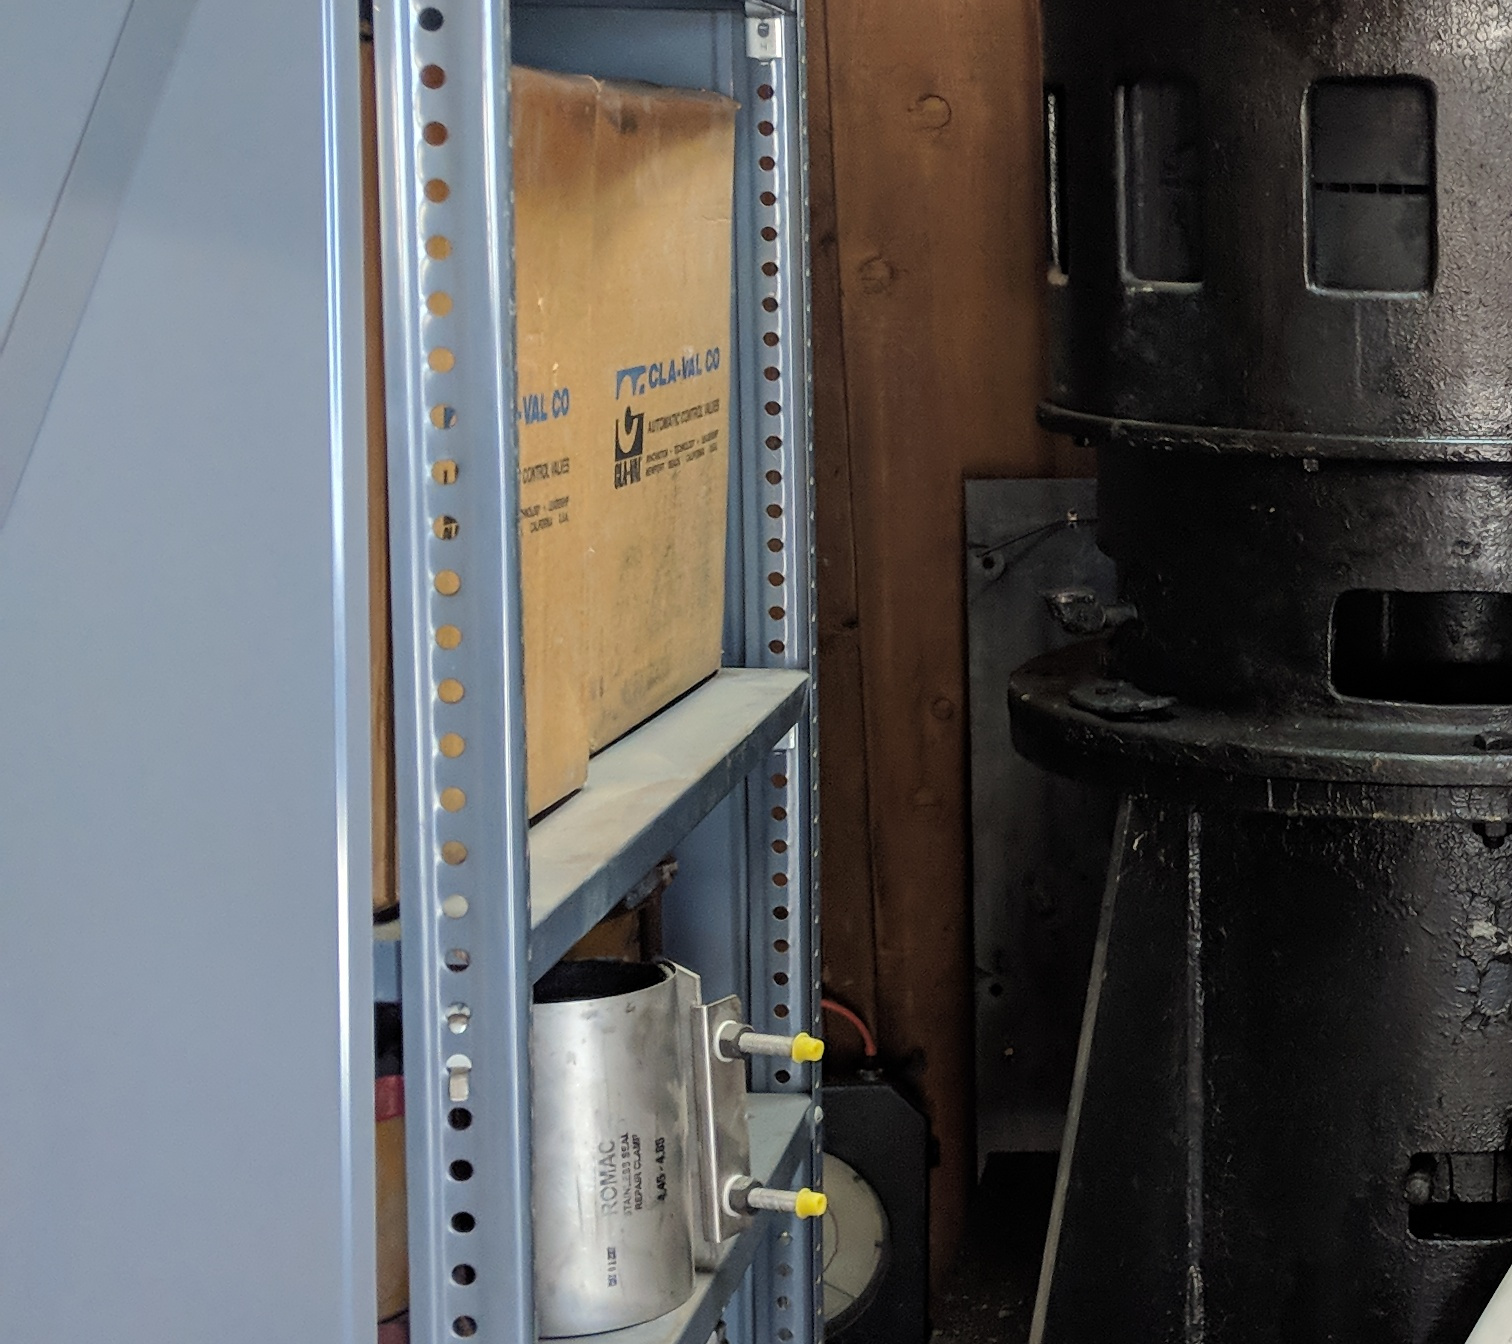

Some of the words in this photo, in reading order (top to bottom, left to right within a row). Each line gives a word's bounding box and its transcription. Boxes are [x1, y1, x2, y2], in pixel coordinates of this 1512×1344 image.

[649, 352, 702, 389] CLA-VAL
[705, 347, 720, 371] CO
[516, 393, 548, 425] -VAL
[551, 387, 570, 419] CO
[599, 1139, 618, 1215] ROMAC
[633, 1171, 643, 1210] REPAIR
